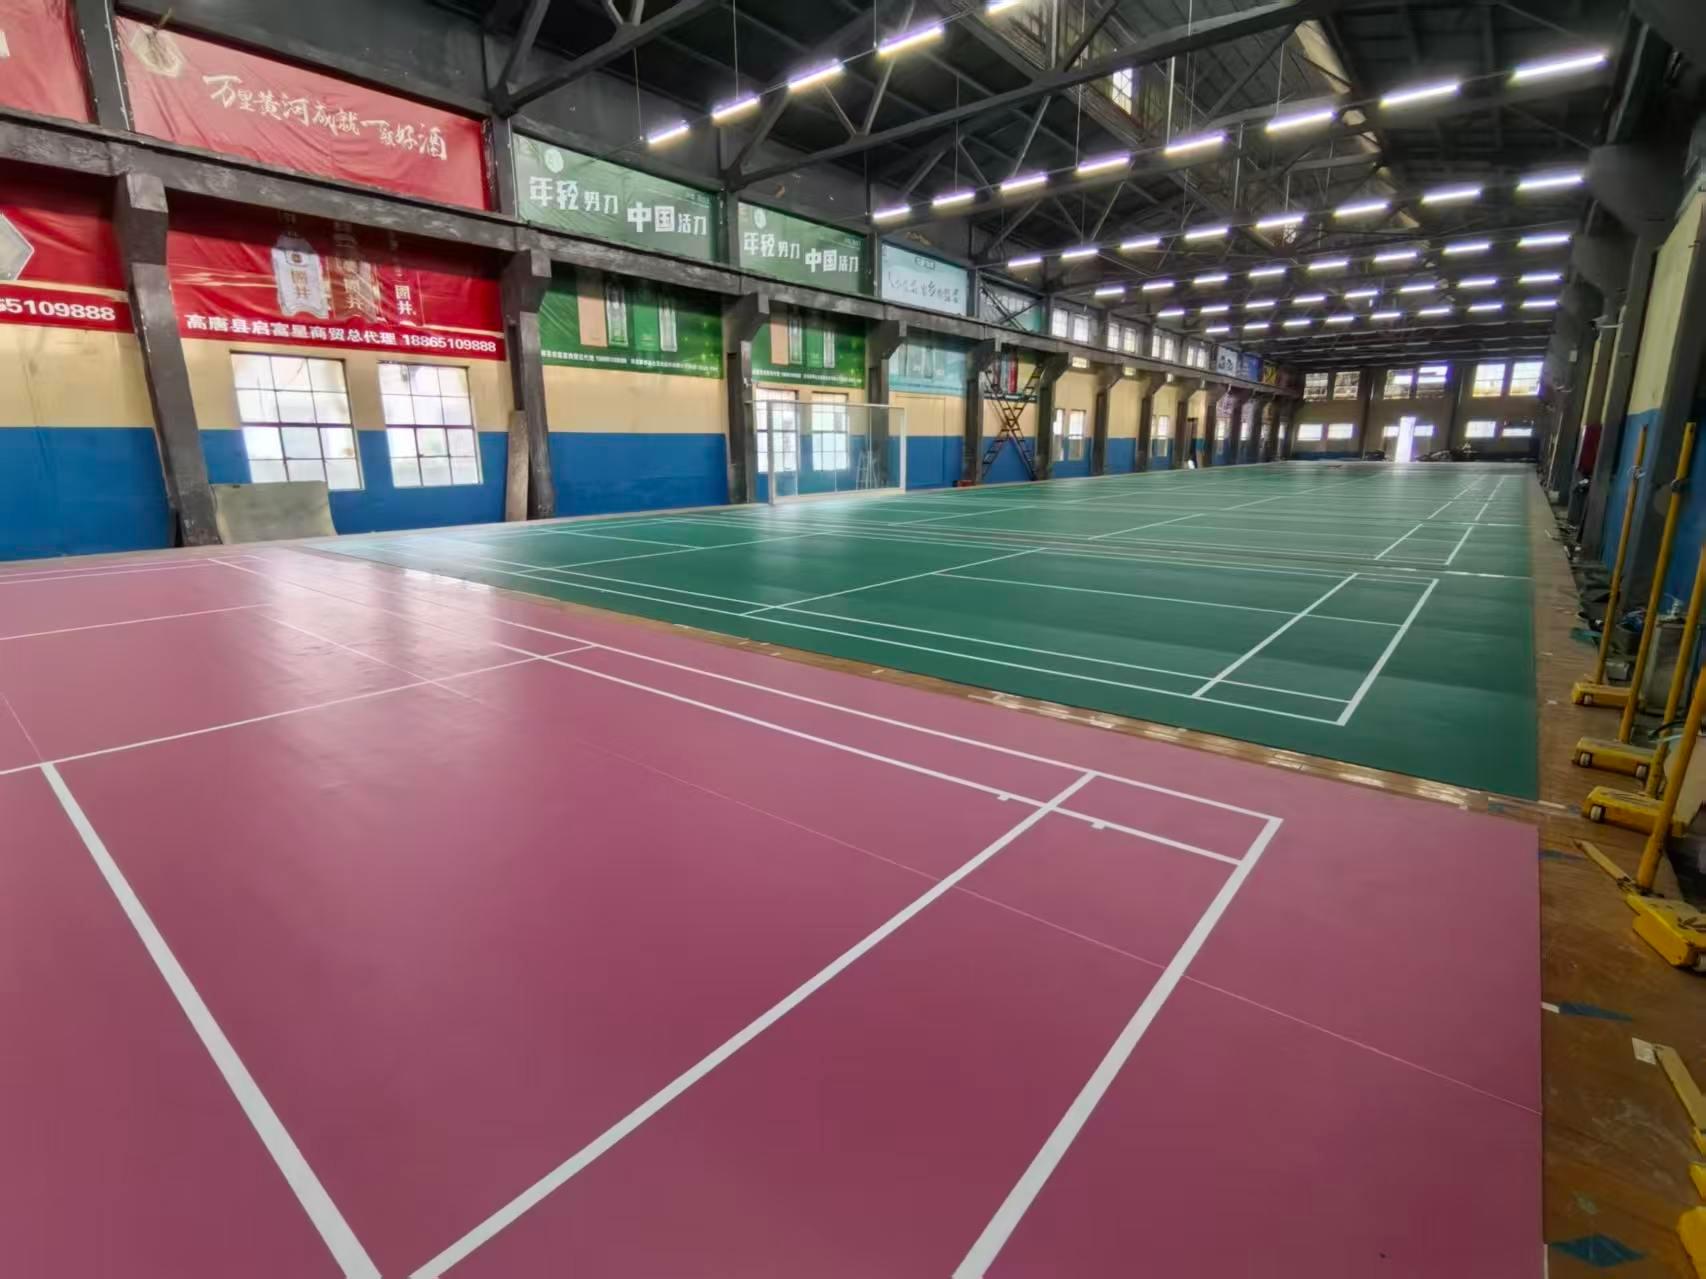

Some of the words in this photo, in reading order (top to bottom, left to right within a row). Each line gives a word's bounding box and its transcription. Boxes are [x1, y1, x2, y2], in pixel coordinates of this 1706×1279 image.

[529, 176, 619, 214] 年轻努力
[627, 201, 707, 236] 中国活力
[402, 333, 497, 353] 18865109888
